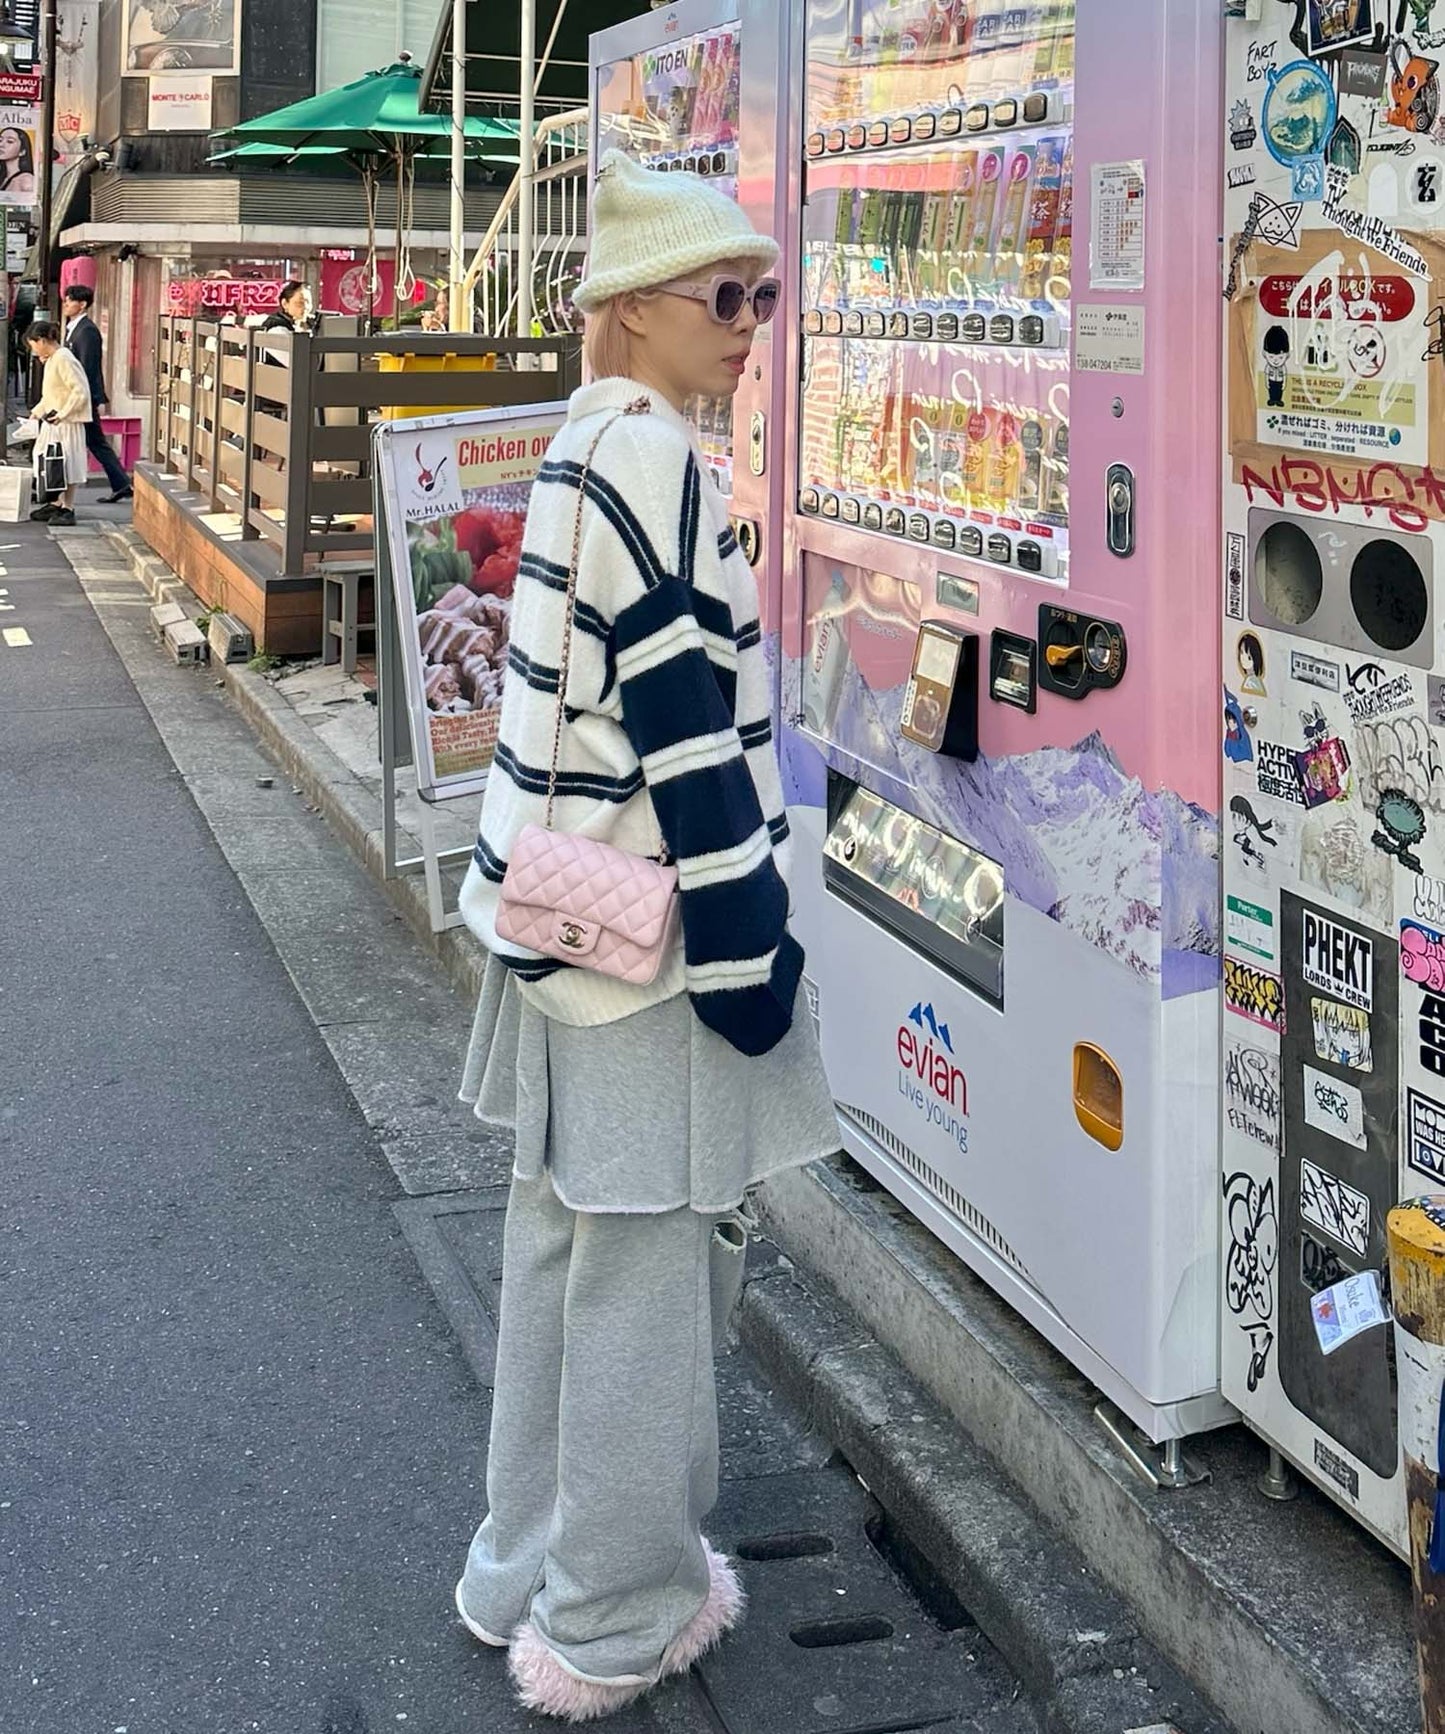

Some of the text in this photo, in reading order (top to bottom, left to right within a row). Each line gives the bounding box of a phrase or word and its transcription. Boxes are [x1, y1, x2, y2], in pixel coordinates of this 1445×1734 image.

[656, 50, 688, 74] ITO EN
[1246, 40, 1278, 66] FART
[184, 93, 210, 101] CARLO
[2, 112, 33, 126] Alba
[1382, 236, 1427, 275] Friends
[458, 437, 526, 467] Chicken
[1304, 913, 1371, 993] PHEKT
[1304, 969, 1371, 1010] LORDS CREW
[897, 1026, 968, 1115] evian
[898, 1070, 968, 1154] Live young
[1415, 1121, 1434, 1141] WAS
